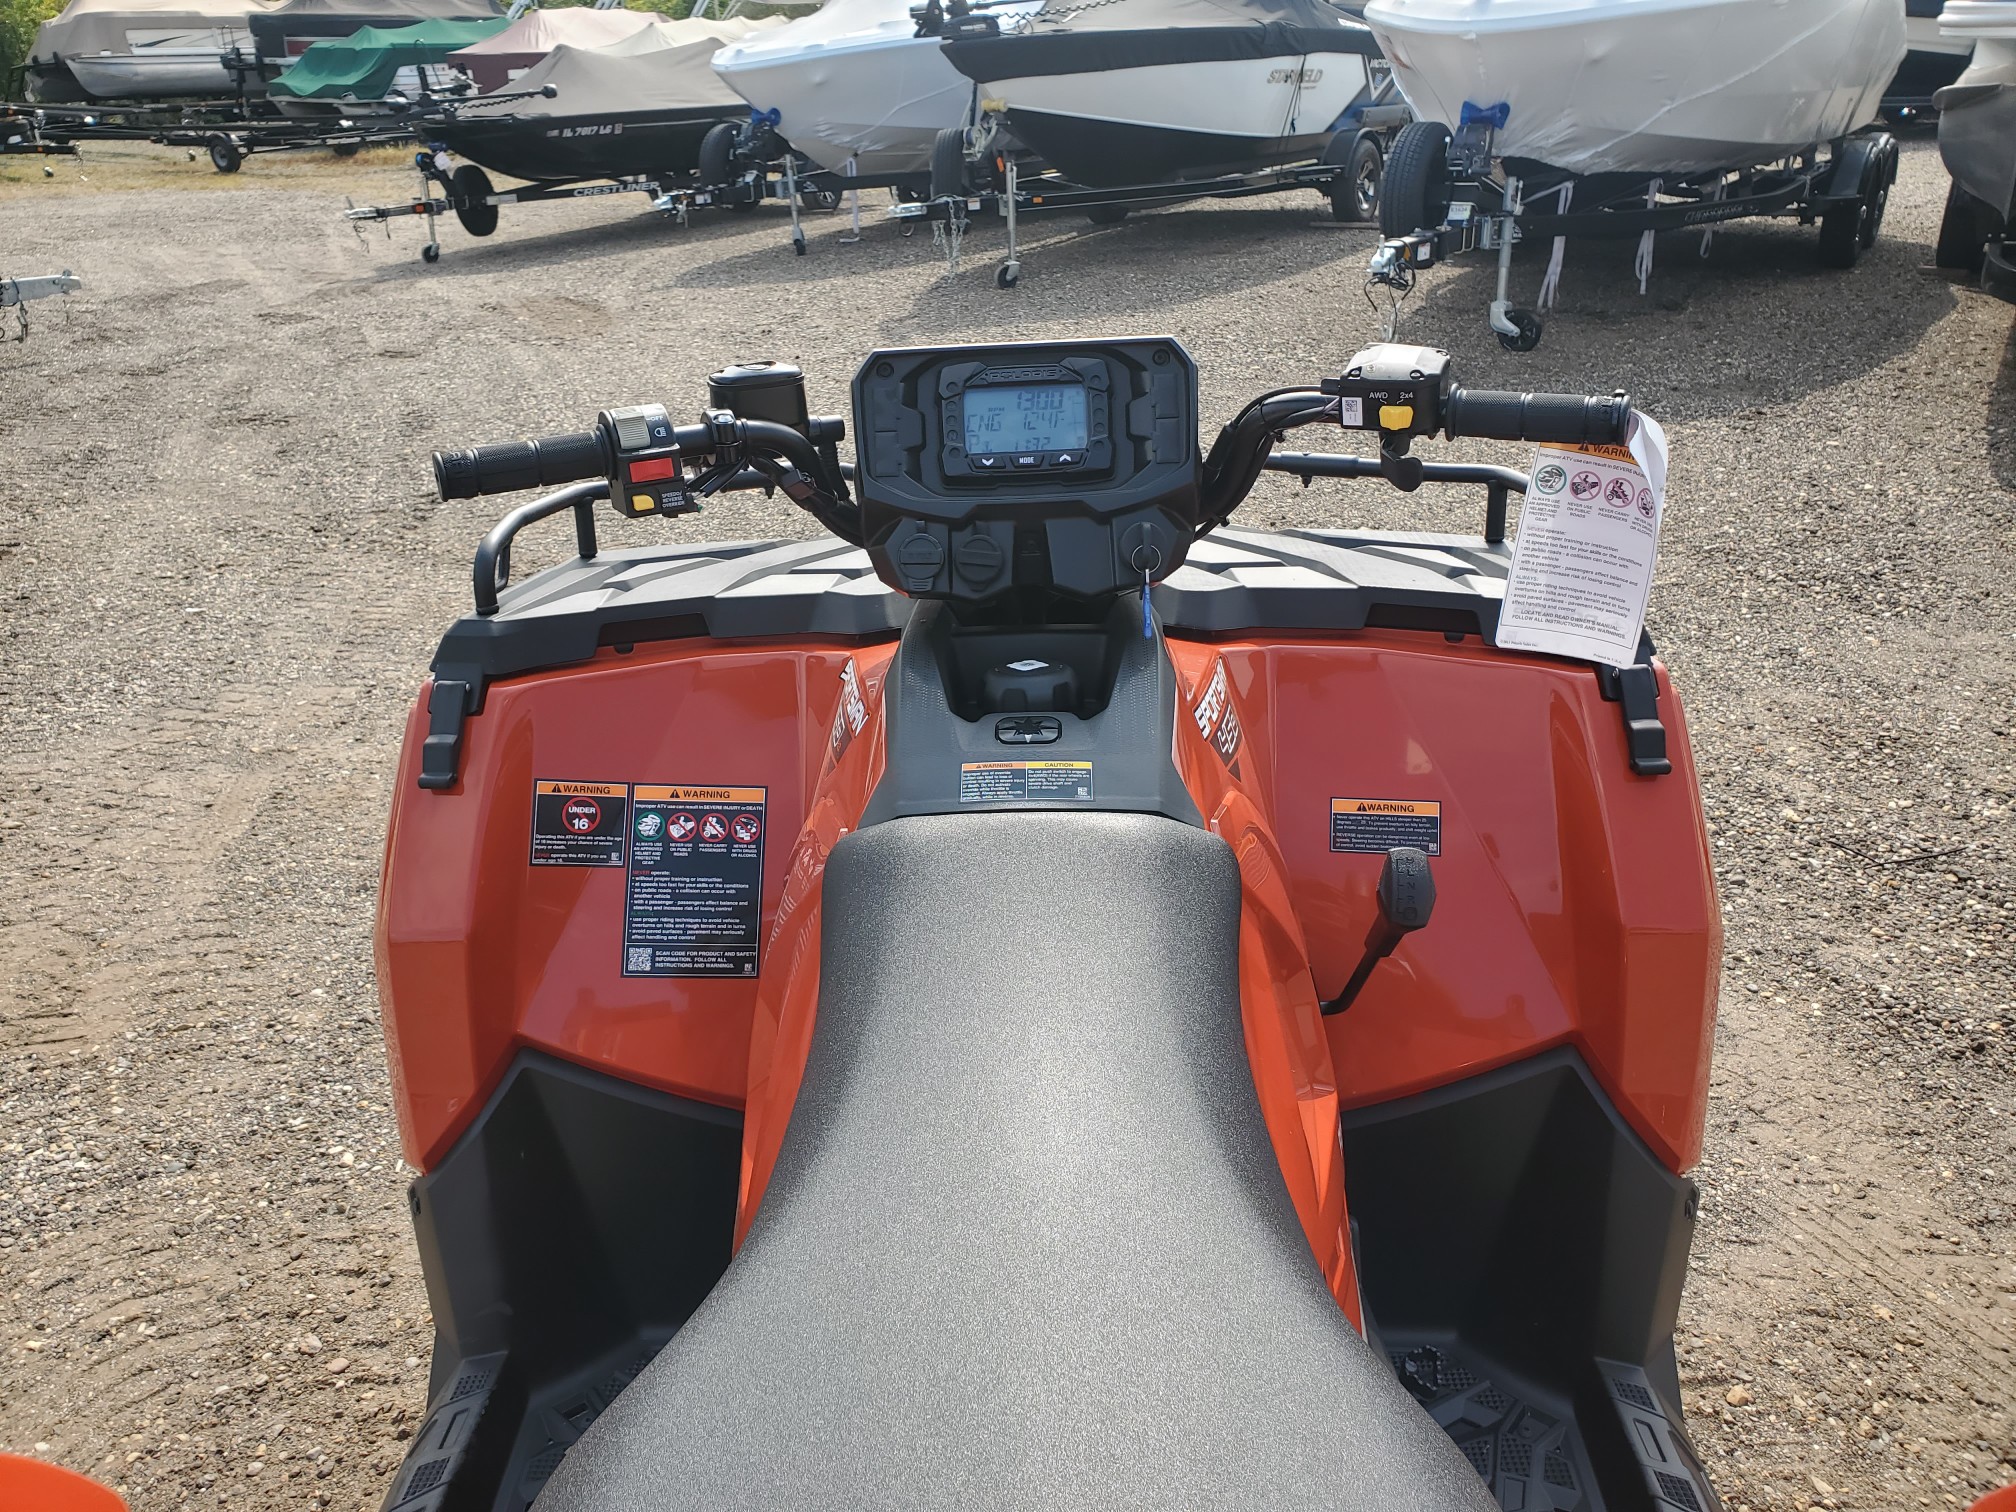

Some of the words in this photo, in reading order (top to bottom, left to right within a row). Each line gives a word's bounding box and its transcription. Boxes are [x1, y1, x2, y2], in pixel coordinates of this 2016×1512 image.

[574, 182, 660, 196] CRESTLINER
[990, 370, 1058, 380] POLARIS
[1593, 444, 1635, 460] WARNIN
[1597, 512, 1627, 522] PASSENGERS
[564, 785, 610, 794] WARNING
[683, 790, 730, 799] WARNING
[1367, 804, 1414, 813] WARNING
[572, 818, 588, 829] 16
